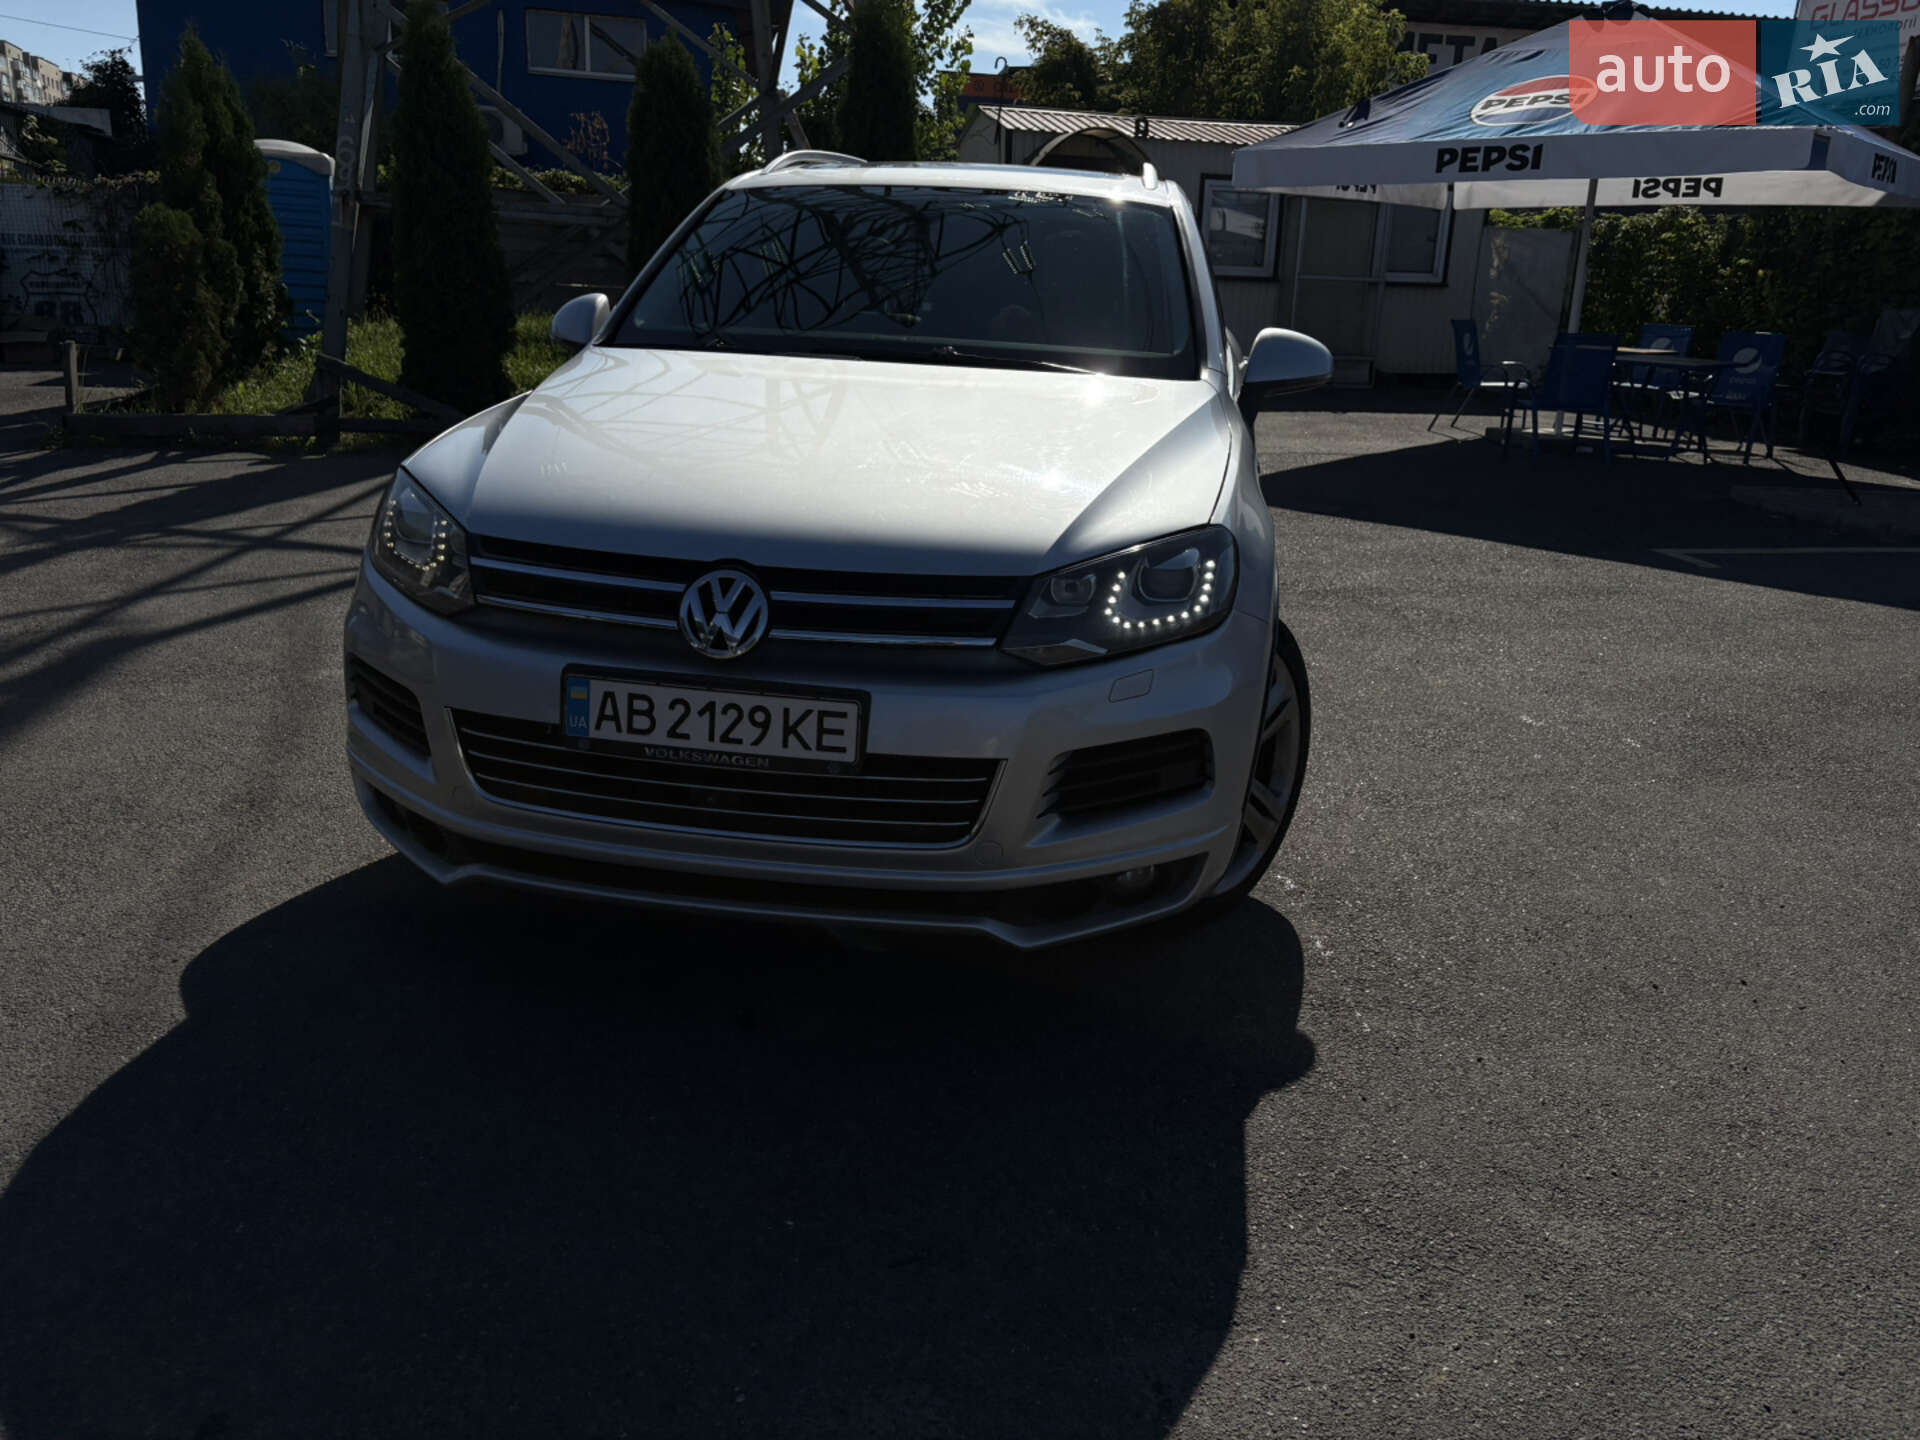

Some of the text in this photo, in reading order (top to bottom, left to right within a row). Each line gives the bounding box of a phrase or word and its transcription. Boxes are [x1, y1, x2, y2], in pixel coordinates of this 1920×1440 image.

[1435, 144, 1543, 173] PEPSI
[569, 715, 589, 729] UA
[595, 691, 848, 753] AB 2129 KE
[644, 747, 770, 767] VOLKSWAGEN
